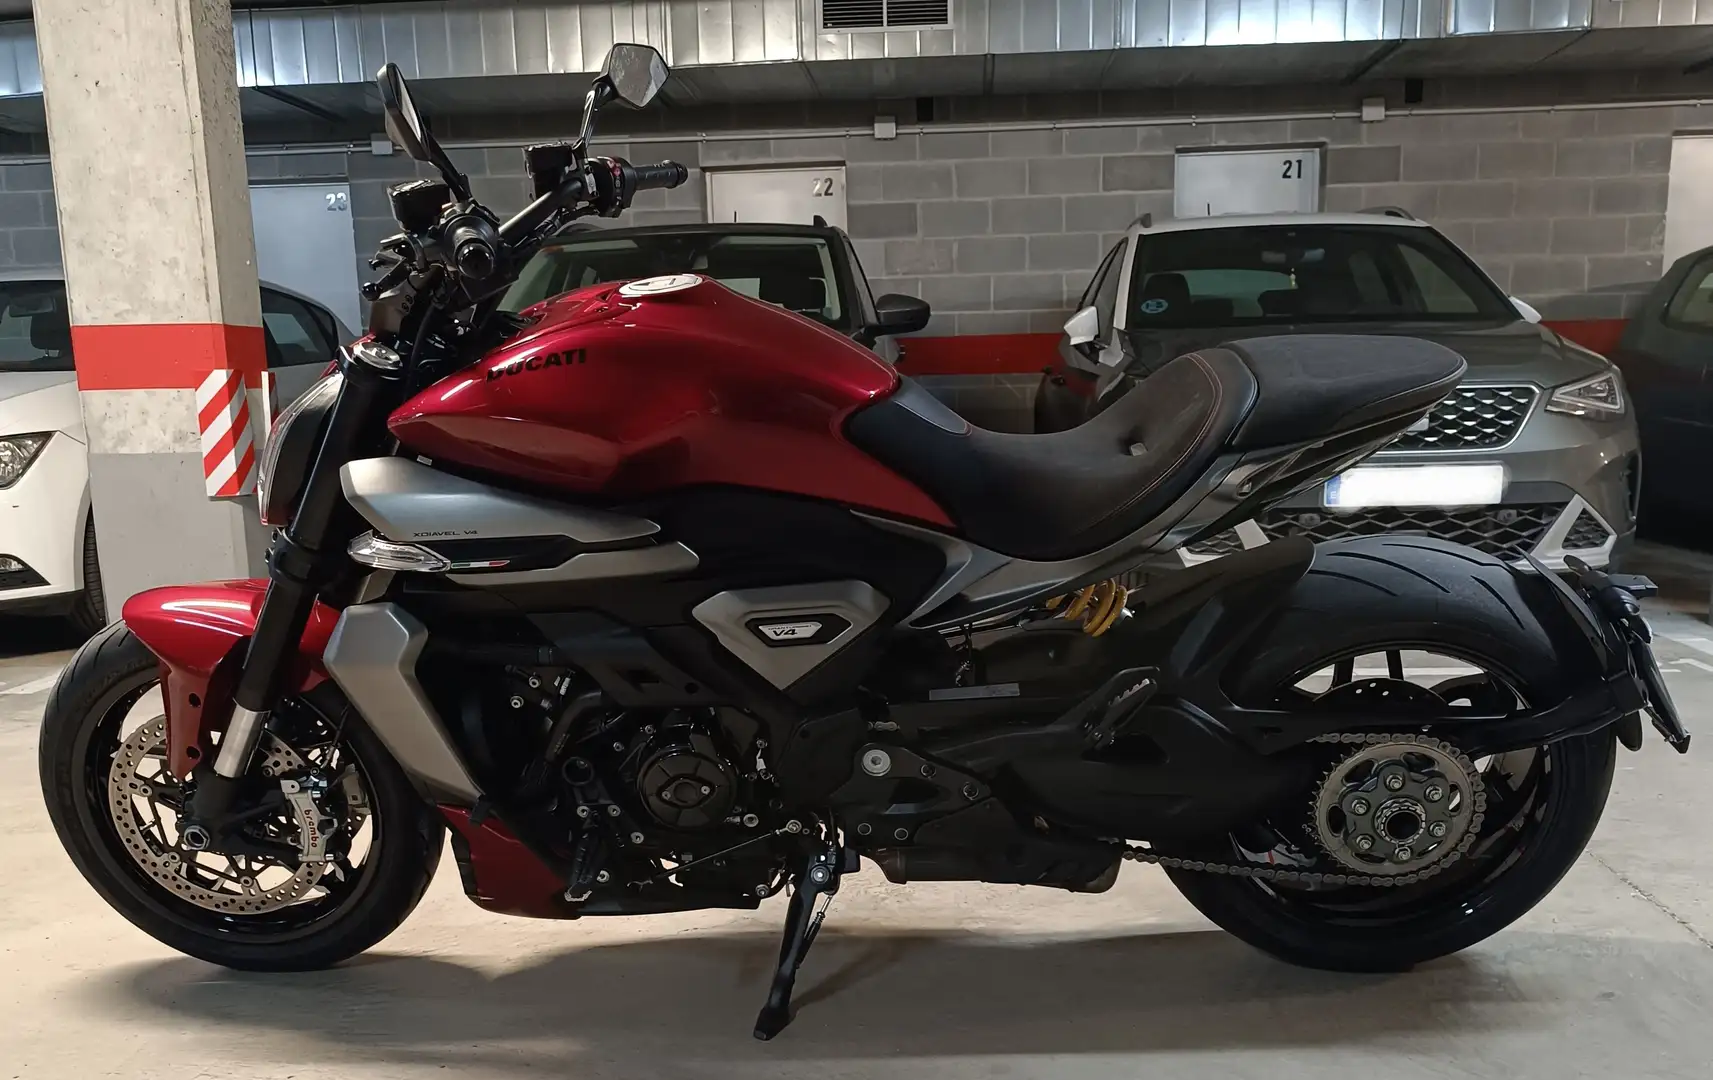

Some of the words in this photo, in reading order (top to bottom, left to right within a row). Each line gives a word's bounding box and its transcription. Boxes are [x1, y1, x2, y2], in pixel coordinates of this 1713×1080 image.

[1282, 159, 1302, 179] 21
[812, 177, 834, 197] 22
[325, 192, 348, 211] 23
[486, 348, 586, 383] DUCATI
[413, 530, 461, 538] XDIAVEL
[772, 628, 798, 637] V4
[304, 808, 320, 848] brembo
